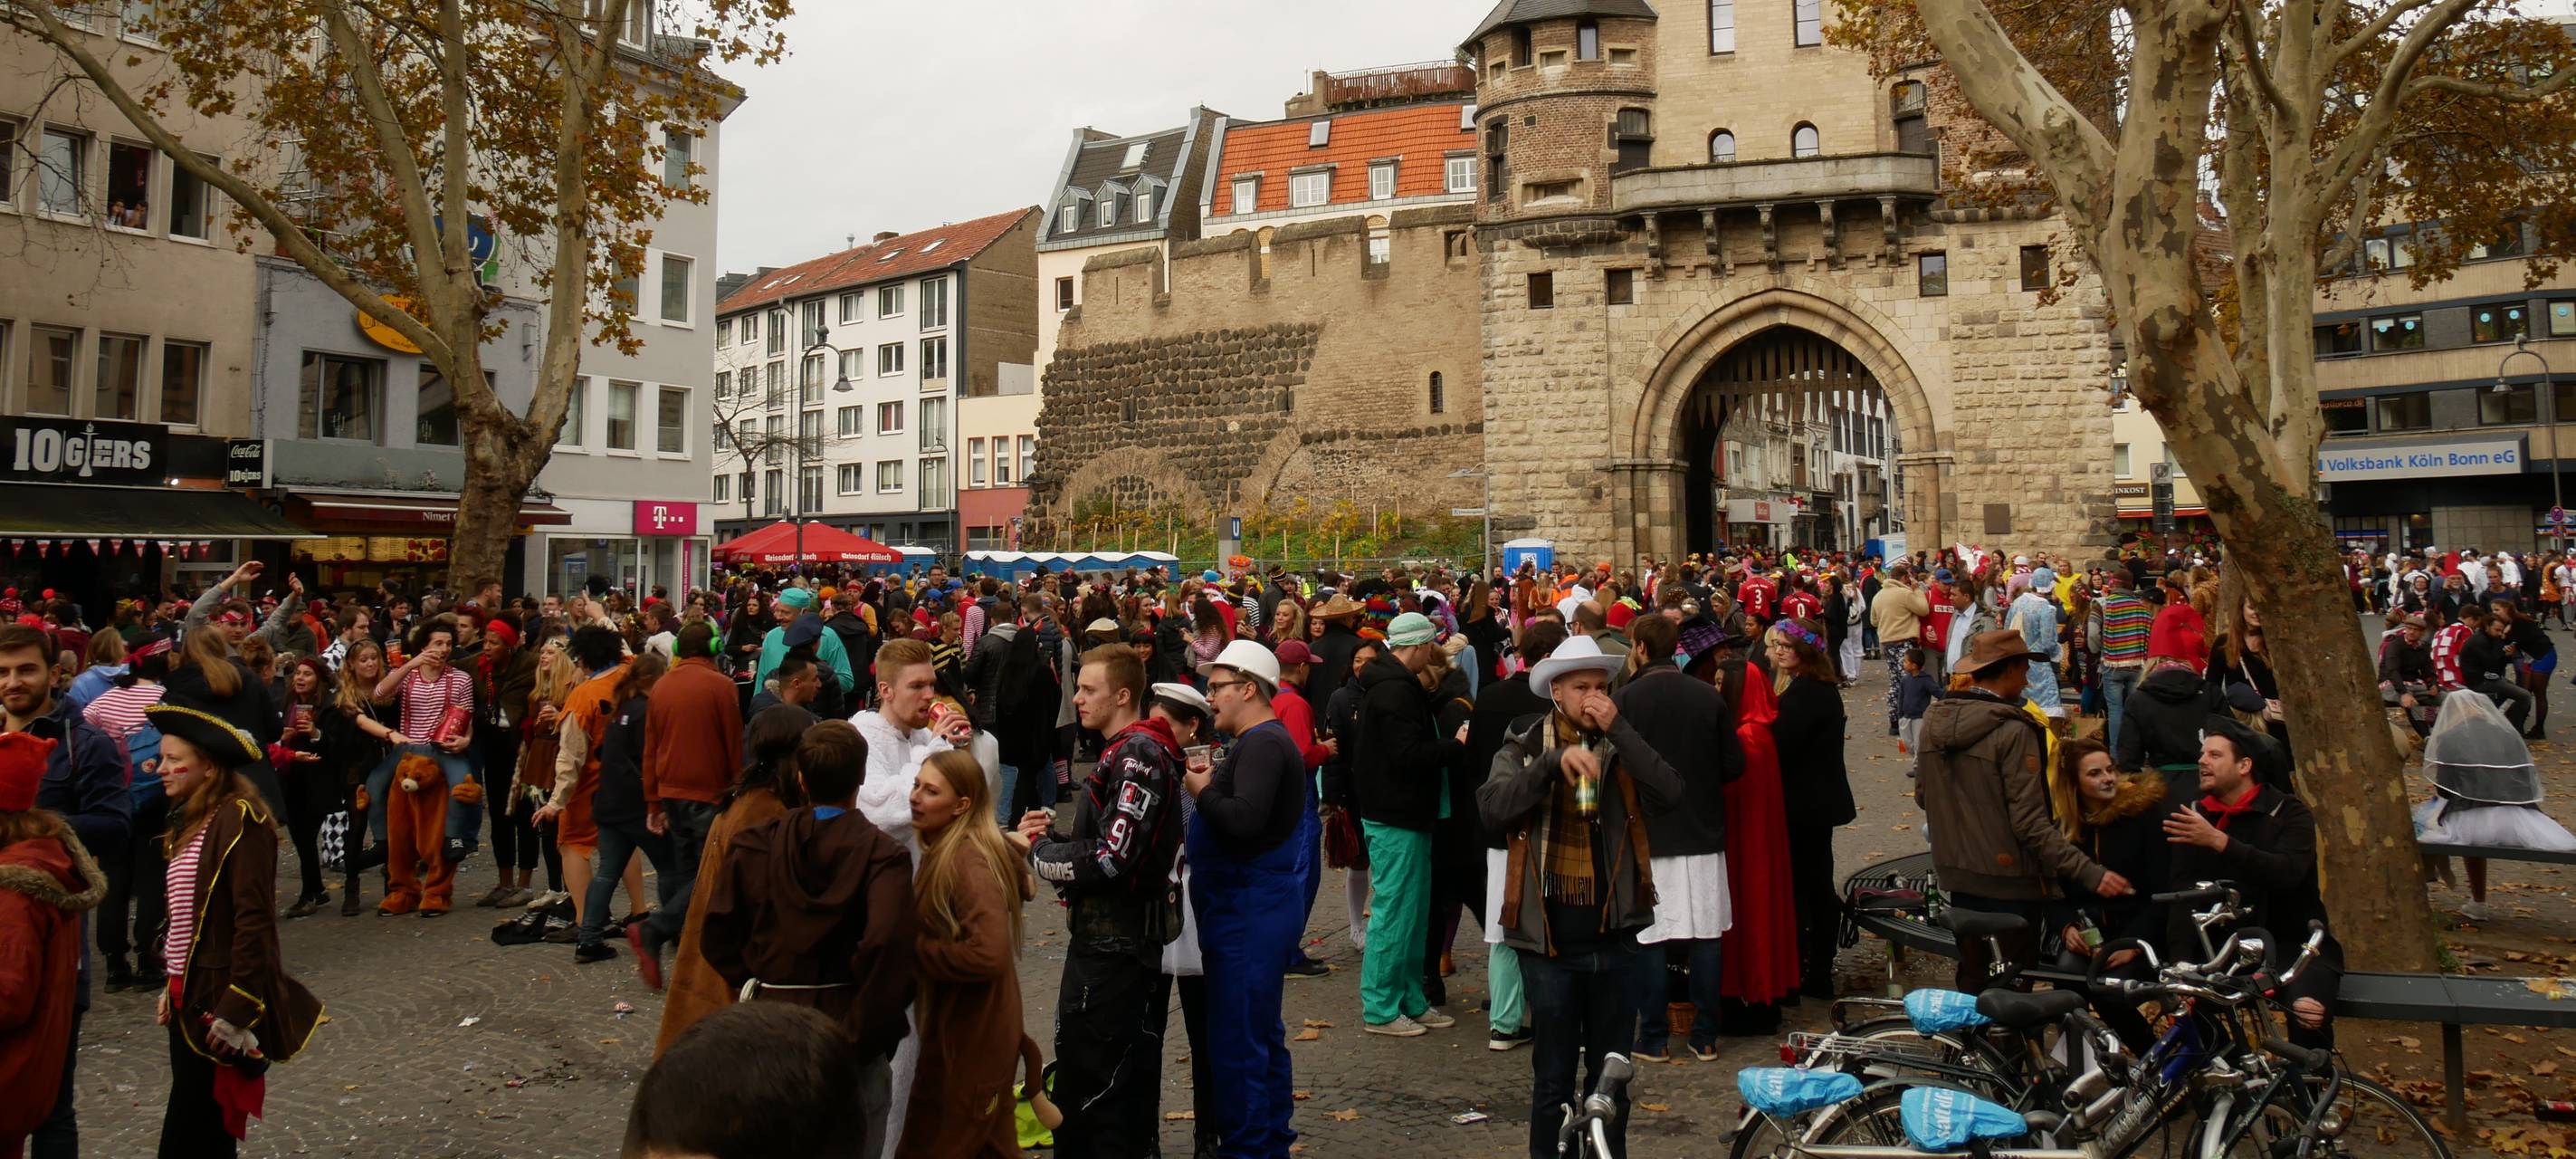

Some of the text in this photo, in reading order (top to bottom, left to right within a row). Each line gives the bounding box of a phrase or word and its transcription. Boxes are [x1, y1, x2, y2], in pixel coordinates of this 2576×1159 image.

[2327, 450, 2515, 472] Volksbank Köln Bonn eG
[423, 511, 451, 522] Nimet
[1233, 521, 1240, 536] U
[1755, 589, 1762, 604] 3
[1797, 603, 1805, 618] 0
